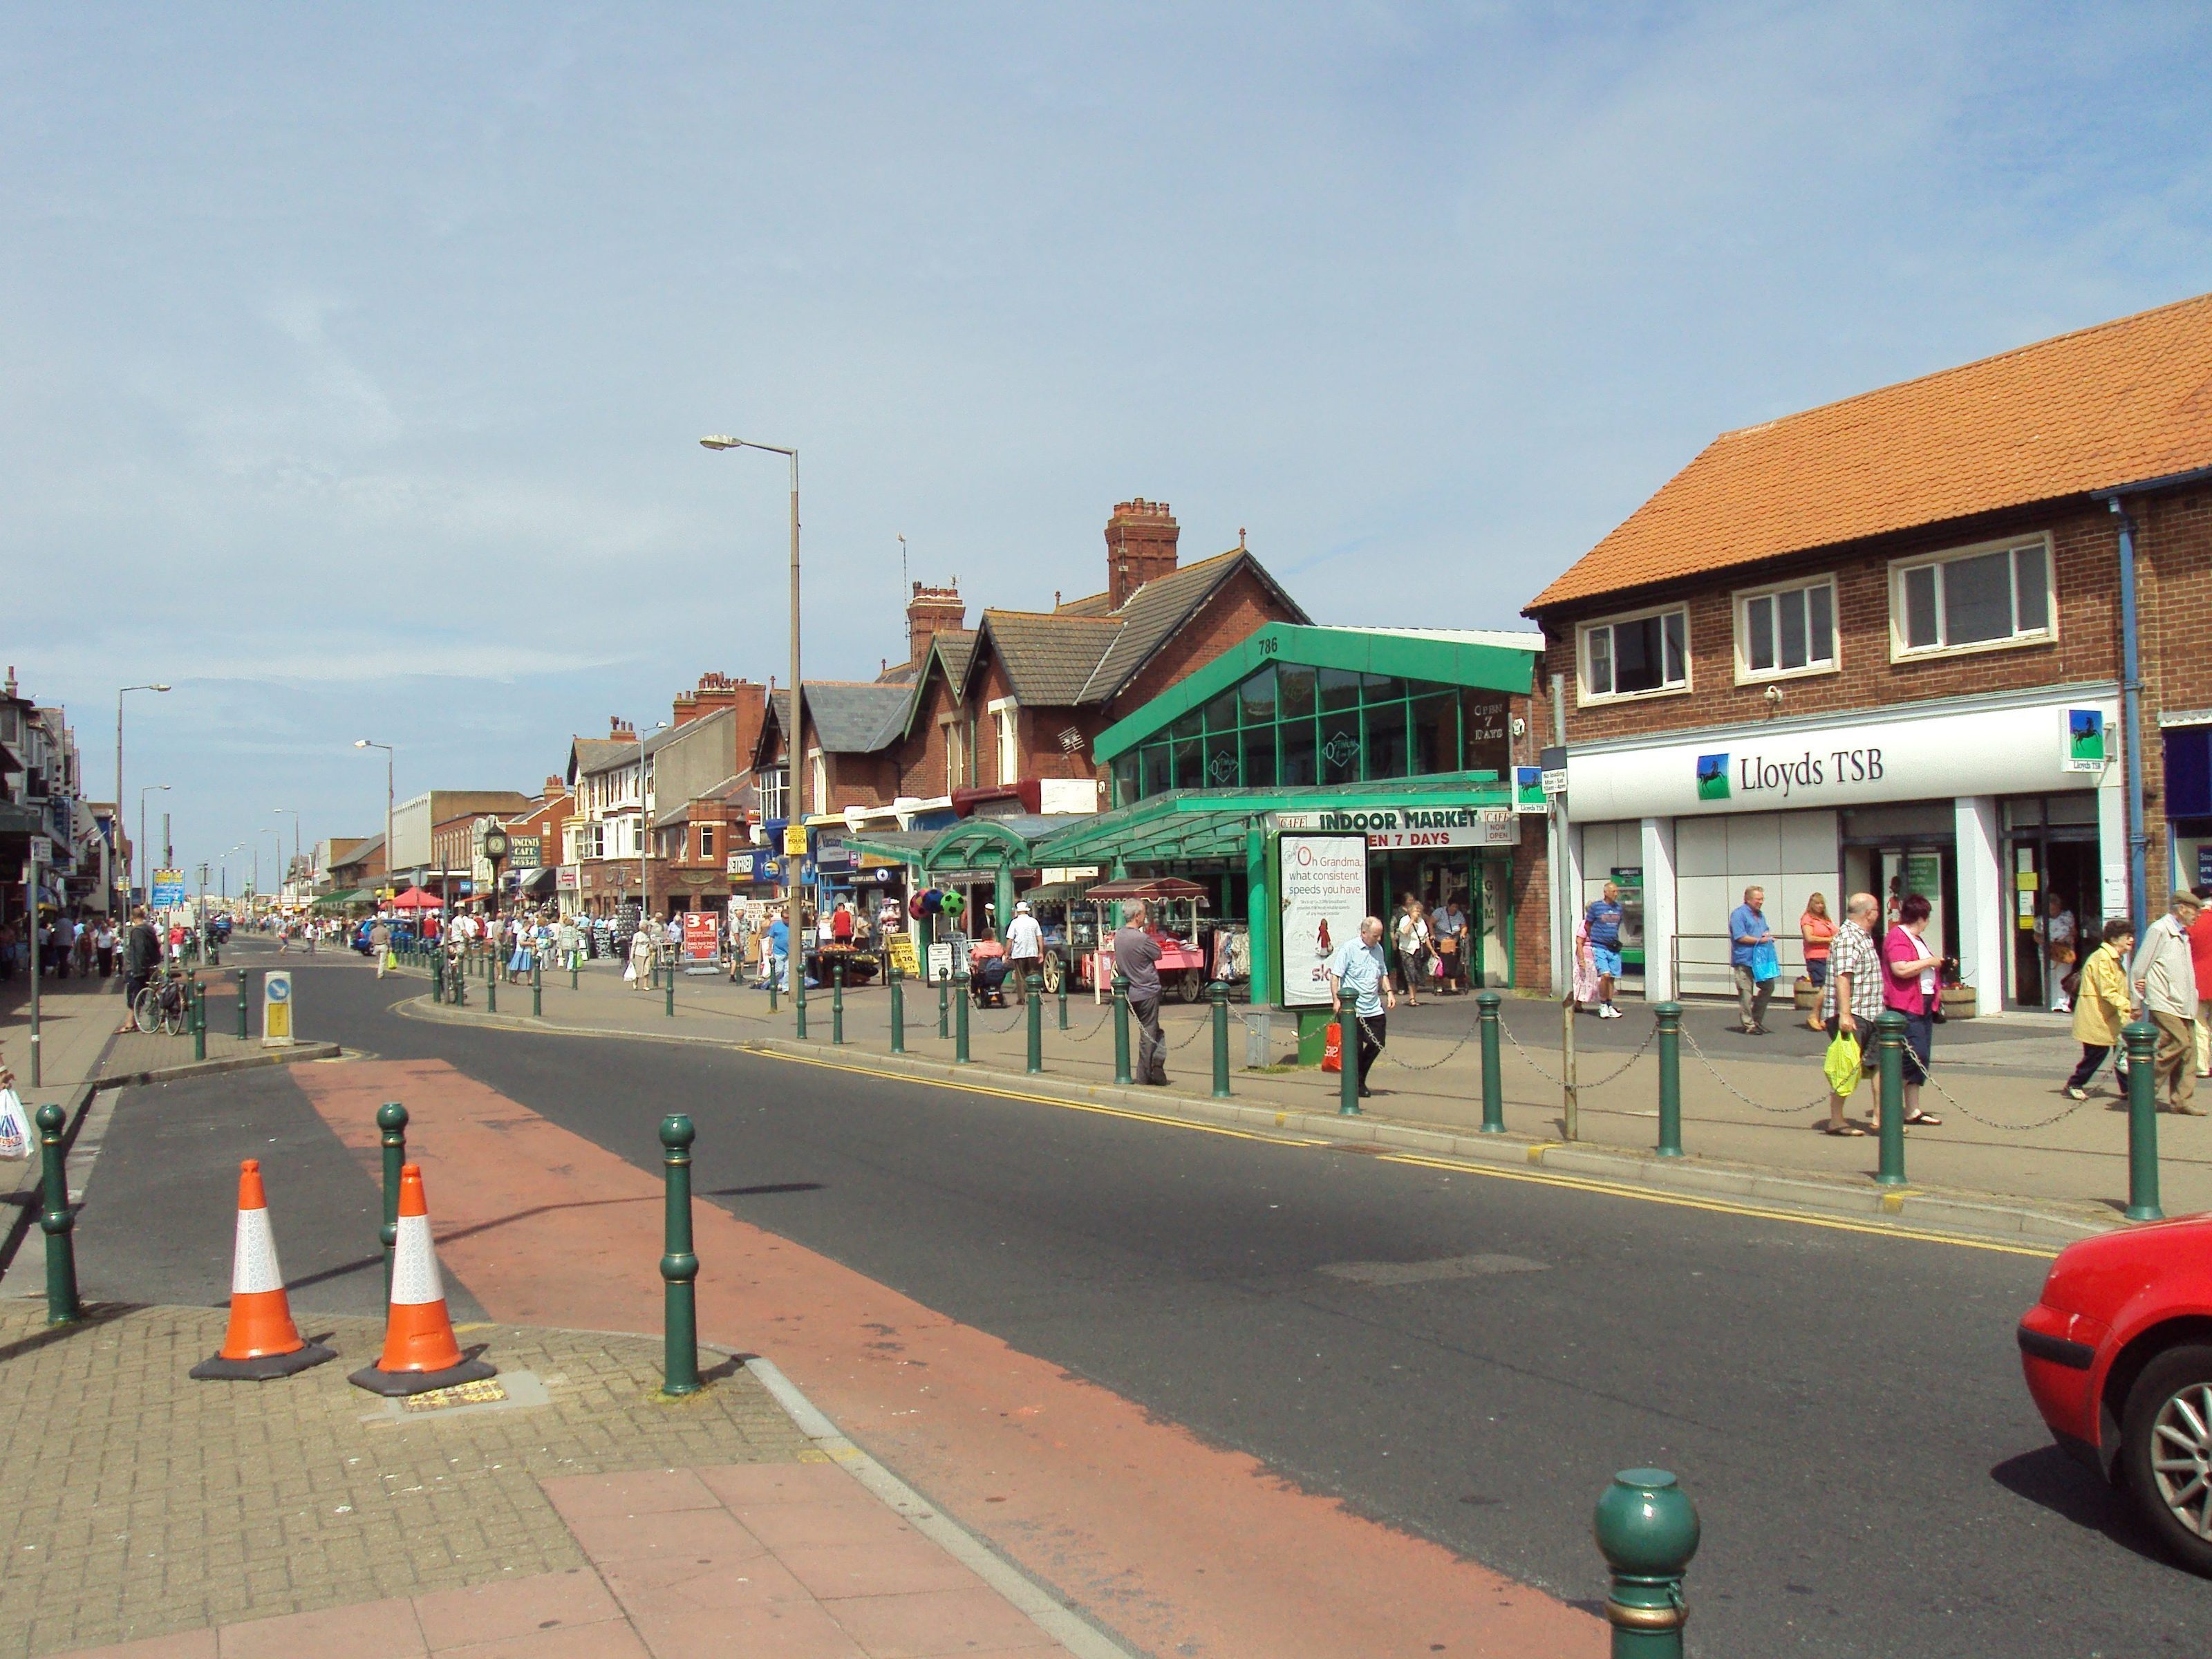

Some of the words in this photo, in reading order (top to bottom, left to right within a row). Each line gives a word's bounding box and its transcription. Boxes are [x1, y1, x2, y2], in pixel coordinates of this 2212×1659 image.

[1259, 637, 1277, 655] 786
[1474, 704, 1503, 716] OPEN
[1485, 717, 1492, 727] 7
[1474, 729, 1503, 740] DAYS
[1740, 751, 1824, 797] Lloyds
[1830, 748, 1884, 782] TSB
[2074, 760, 2091, 771] Lloyds
[1280, 818, 1306, 829] CAFE
[1319, 814, 1397, 830] INDOOR
[1404, 809, 1478, 829] MARKET
[1485, 812, 1510, 823] CAFE
[511, 836, 539, 847] VINCENTS
[1369, 834, 1389, 847] EN
[1394, 834, 1403, 845] 7
[1411, 832, 1450, 845] DAYS
[1297, 846, 1318, 866] Oh
[1320, 856, 1362, 868] Grandma,
[1289, 870, 1311, 881] what
[1313, 871, 1360, 881] consistent
[1289, 885, 1321, 897] speeds
[1323, 888, 1338, 896] you
[1340, 885, 1360, 894] have
[1485, 880, 1494, 919] GYM
[687, 915, 700, 928] 3
[704, 918, 715, 931] 1
[1311, 964, 1331, 982] sk
